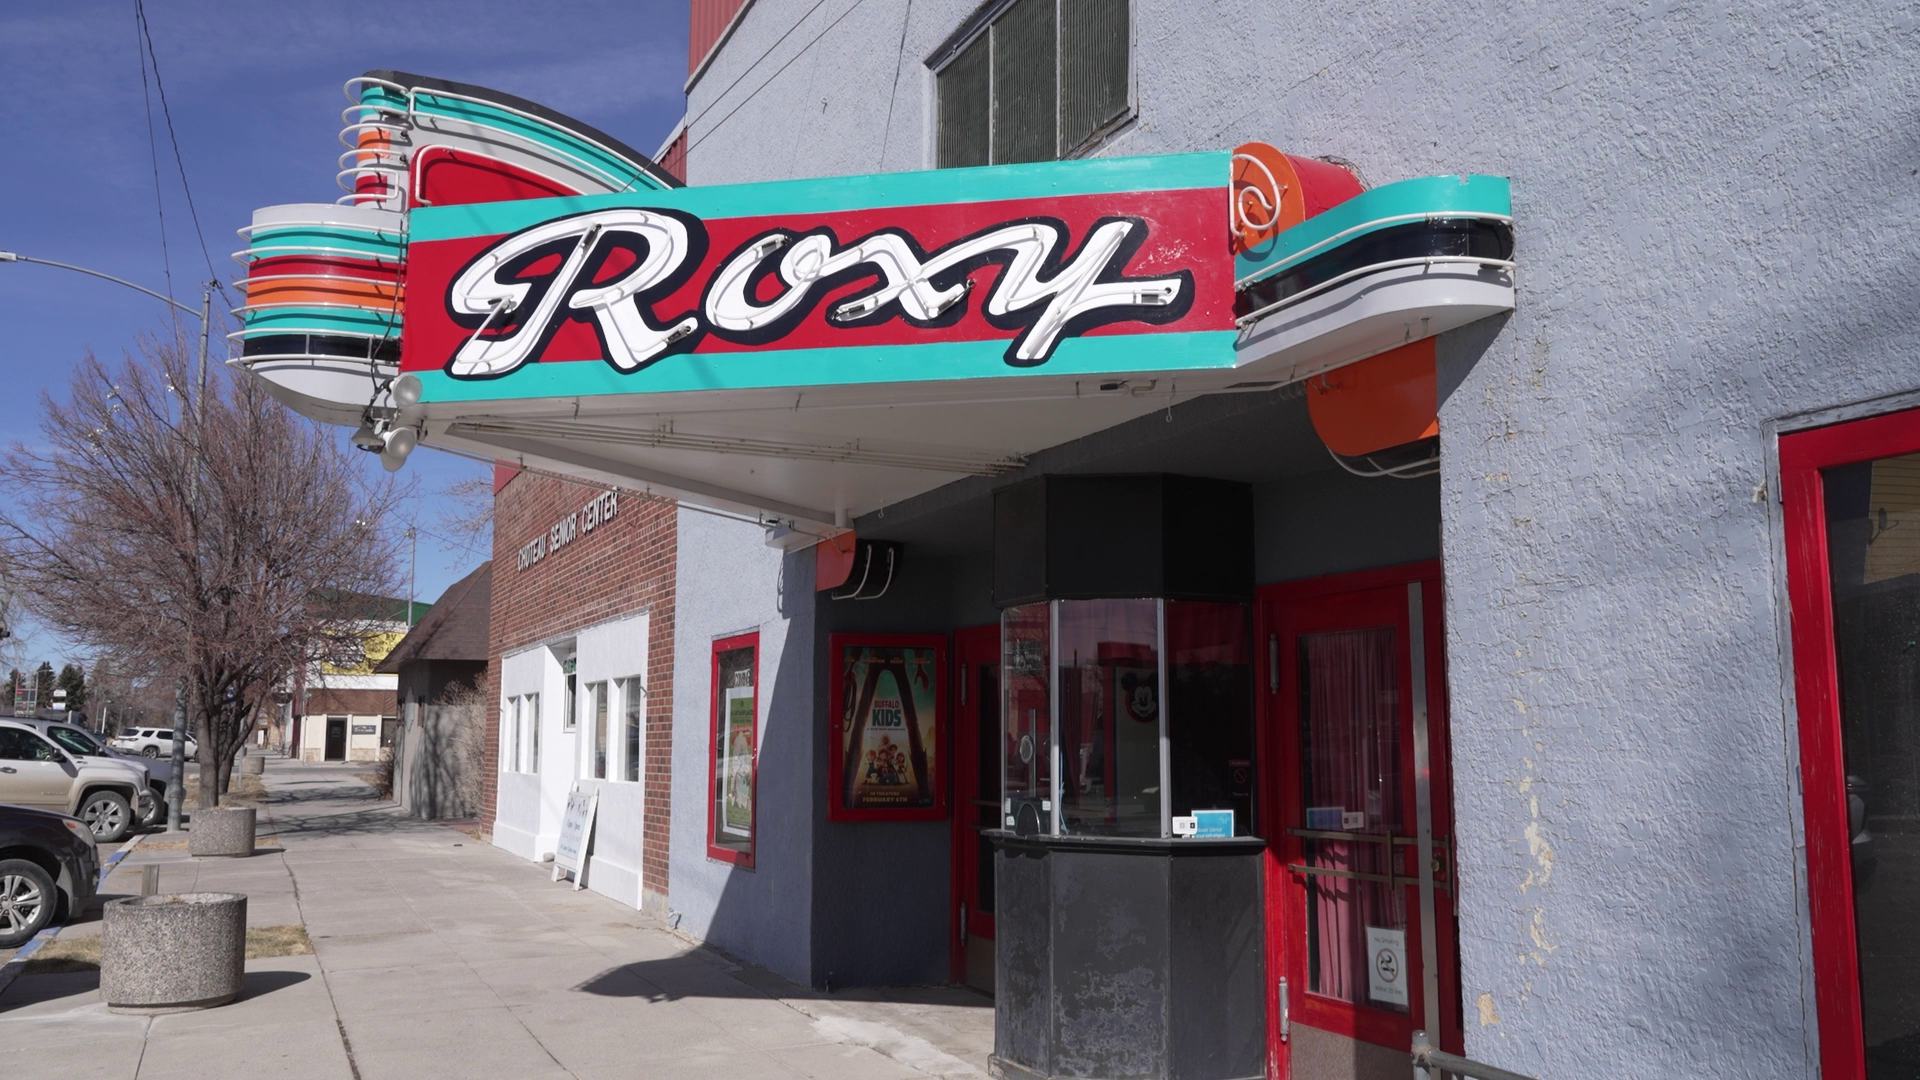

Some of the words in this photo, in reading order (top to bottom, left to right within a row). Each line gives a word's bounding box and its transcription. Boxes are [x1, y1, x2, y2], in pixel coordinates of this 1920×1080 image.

[447, 206, 1187, 378] Roxy
[517, 533, 547, 572] CHOTEAU
[550, 512, 578, 553] SENIOR
[581, 486, 619, 534] CENTER
[874, 700, 900, 709] BUFFALO
[872, 708, 902, 727] KIDS
[1381, 937, 1399, 946] Smoking
